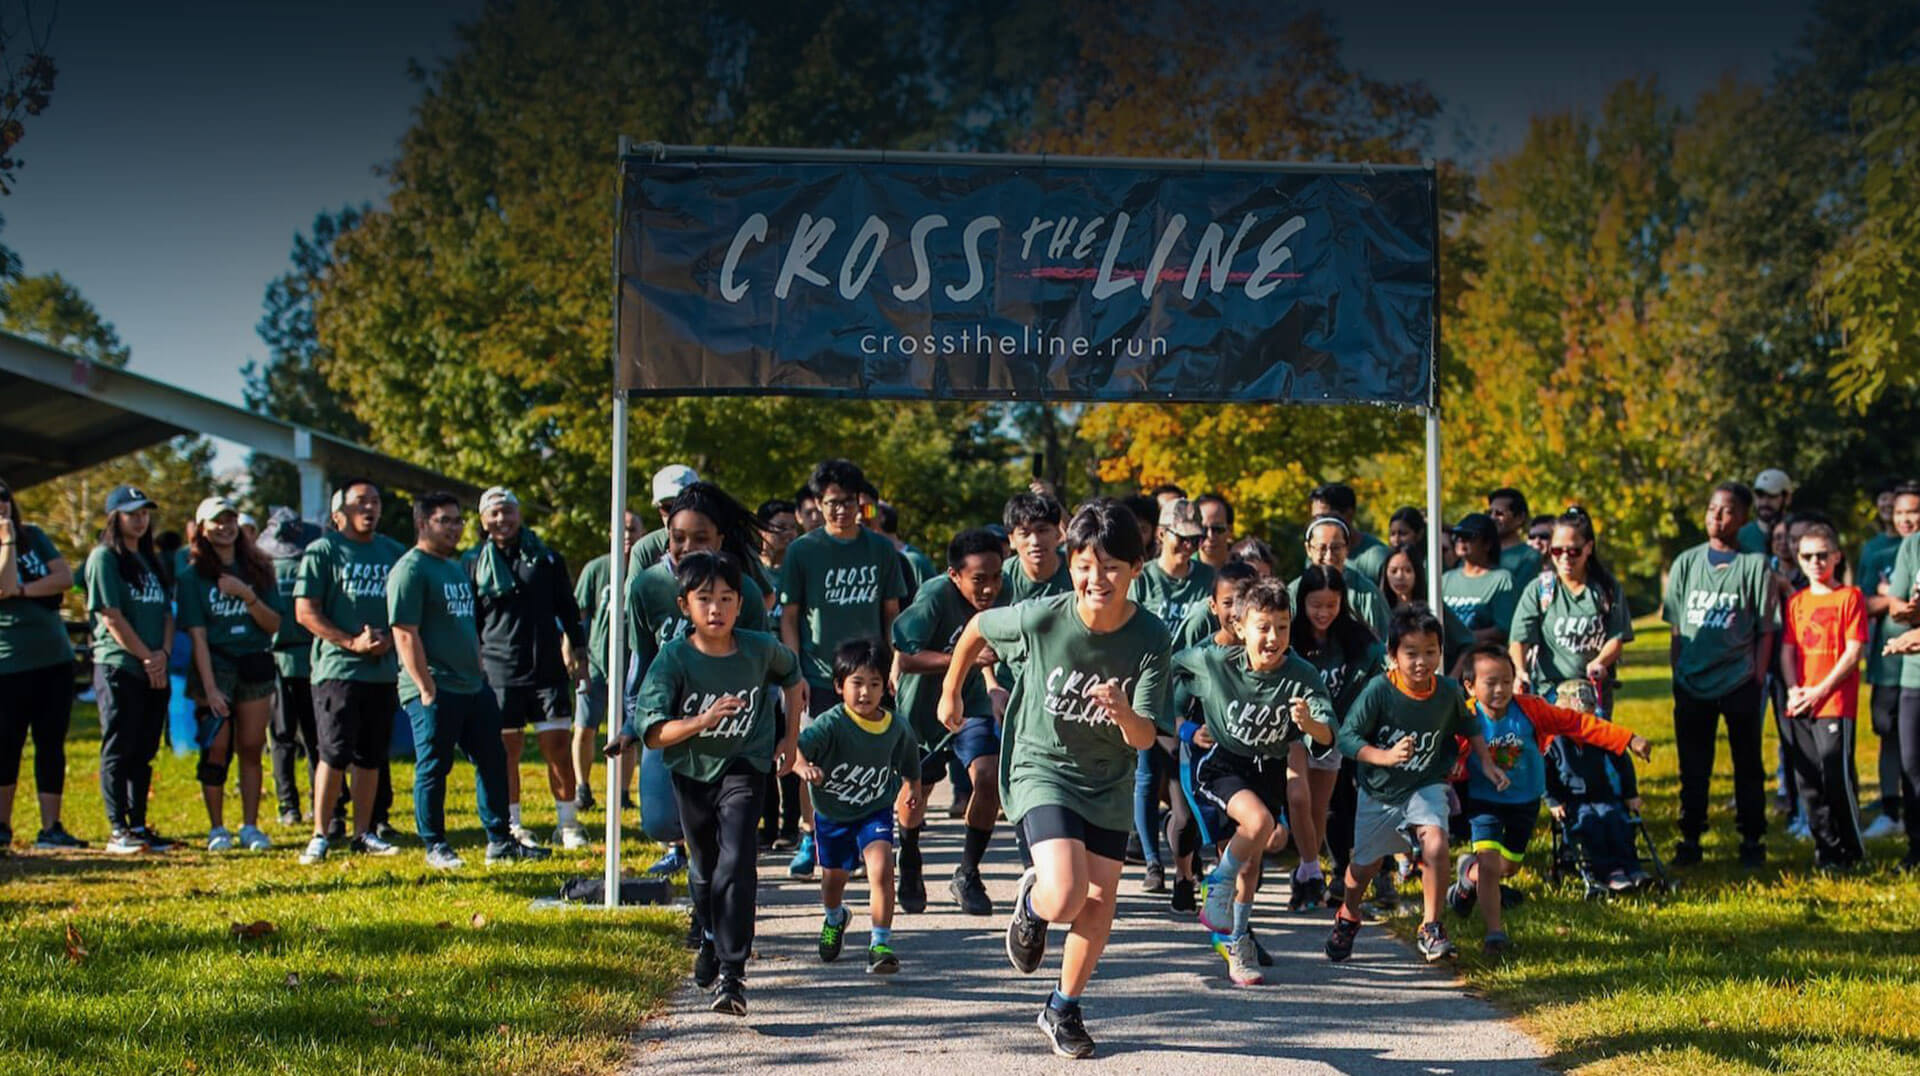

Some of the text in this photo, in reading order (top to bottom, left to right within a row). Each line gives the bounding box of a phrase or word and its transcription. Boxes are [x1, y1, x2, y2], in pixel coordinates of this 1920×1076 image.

[720, 212, 1001, 302] CROSS
[1091, 211, 1307, 300] LINE
[860, 324, 1168, 357] crosstheline.run
[825, 565, 878, 588] CROSS
[839, 585, 879, 605] LINE
[1554, 616, 1604, 636] CROSS
